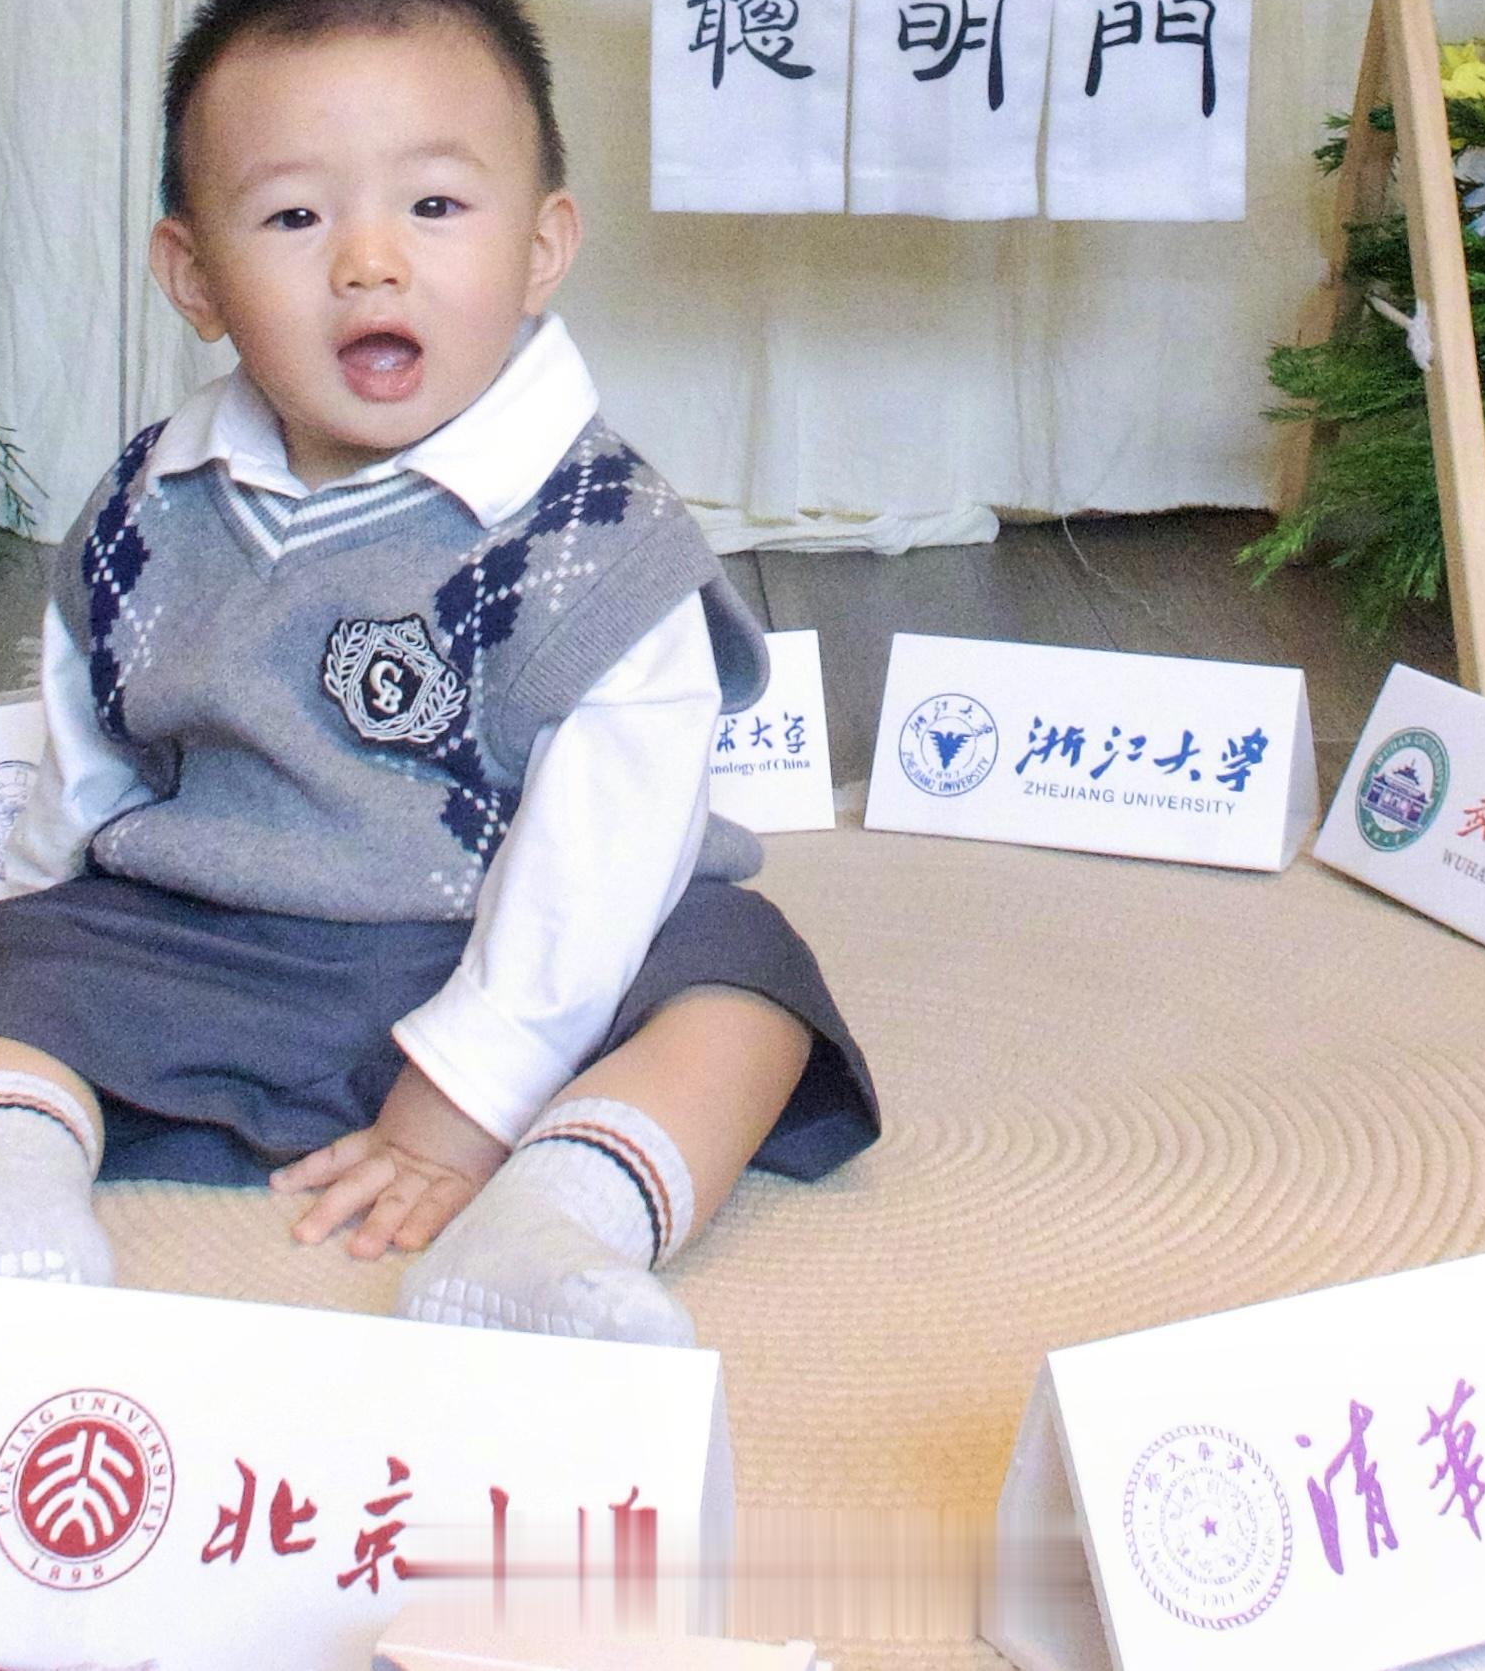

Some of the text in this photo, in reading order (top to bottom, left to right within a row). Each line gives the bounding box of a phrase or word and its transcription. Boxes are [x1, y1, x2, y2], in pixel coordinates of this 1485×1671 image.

[774, 758, 811, 771] China
[1023, 781, 1237, 816] ZHEJIANG UNIVERSITY
[70, 1396, 168, 1538] UNIVERSITY
[29, 1556, 105, 1585] 1898
